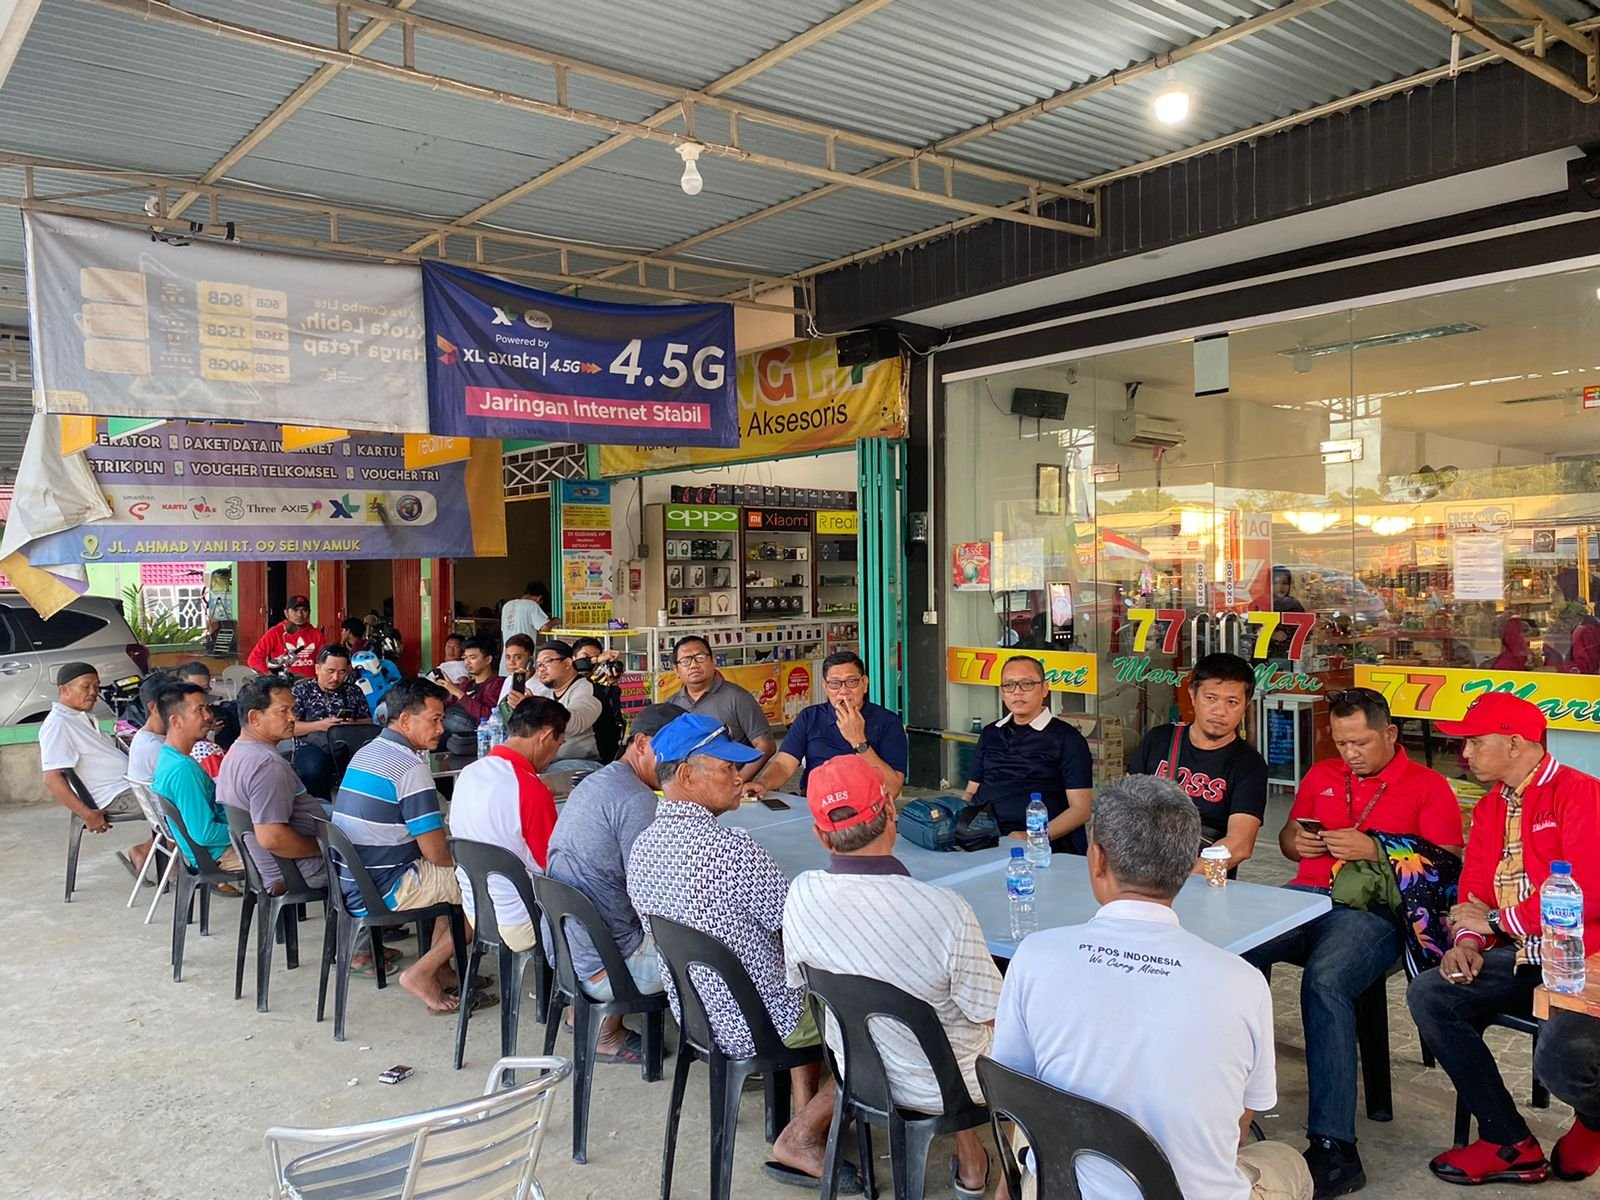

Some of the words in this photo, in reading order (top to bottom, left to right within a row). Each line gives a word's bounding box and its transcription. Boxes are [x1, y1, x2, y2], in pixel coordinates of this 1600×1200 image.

[495, 334, 536, 347] Powered
[538, 338, 550, 349] by
[463, 349, 485, 363] XL
[488, 352, 540, 369] axiata
[550, 359, 580, 373] 4.5G
[608, 338, 727, 390] 4.5G
[479, 391, 570, 417] Jaringan
[573, 400, 648, 421] Internet
[652, 404, 702, 423] Stabil
[747, 399, 848, 437] Aksesoris
[184, 436, 230, 450] PAKET
[237, 438, 268, 451] DATA
[356, 445, 398, 457] KARTU
[135, 461, 165, 475] PLN
[190, 462, 259, 477] VOUCHER
[261, 464, 338, 479] TELKOMSEL
[361, 468, 418, 481] VOUCHER
[421, 469, 441, 481] TRI
[162, 503, 188, 511] KARTU
[247, 504, 277, 513] Three
[280, 504, 309, 513] AXIS
[667, 510, 738, 527] oppo
[765, 513, 809, 527] Xiaomi
[107, 540, 131, 553] JL.
[135, 541, 189, 554] AHMAD
[193, 540, 228, 553] YANI
[232, 540, 253, 553] RT.
[255, 540, 276, 552] 09
[279, 540, 300, 552] SEI
[303, 540, 361, 552] NYAMUK
[1127, 608, 1187, 654] 77
[1247, 611, 1317, 661] 77
[956, 651, 998, 681] 77
[1370, 671, 1447, 712] 77
[821, 789, 849, 807] ARES
[1548, 906, 1576, 918] AQUA
[1078, 943, 1096, 953] PT.
[1098, 946, 1120, 957] POS
[1123, 951, 1182, 967] INDONESIA
[1088, 953, 1103, 964] We
[1106, 957, 1135, 974] Carry
[1137, 963, 1171, 977] Mission
